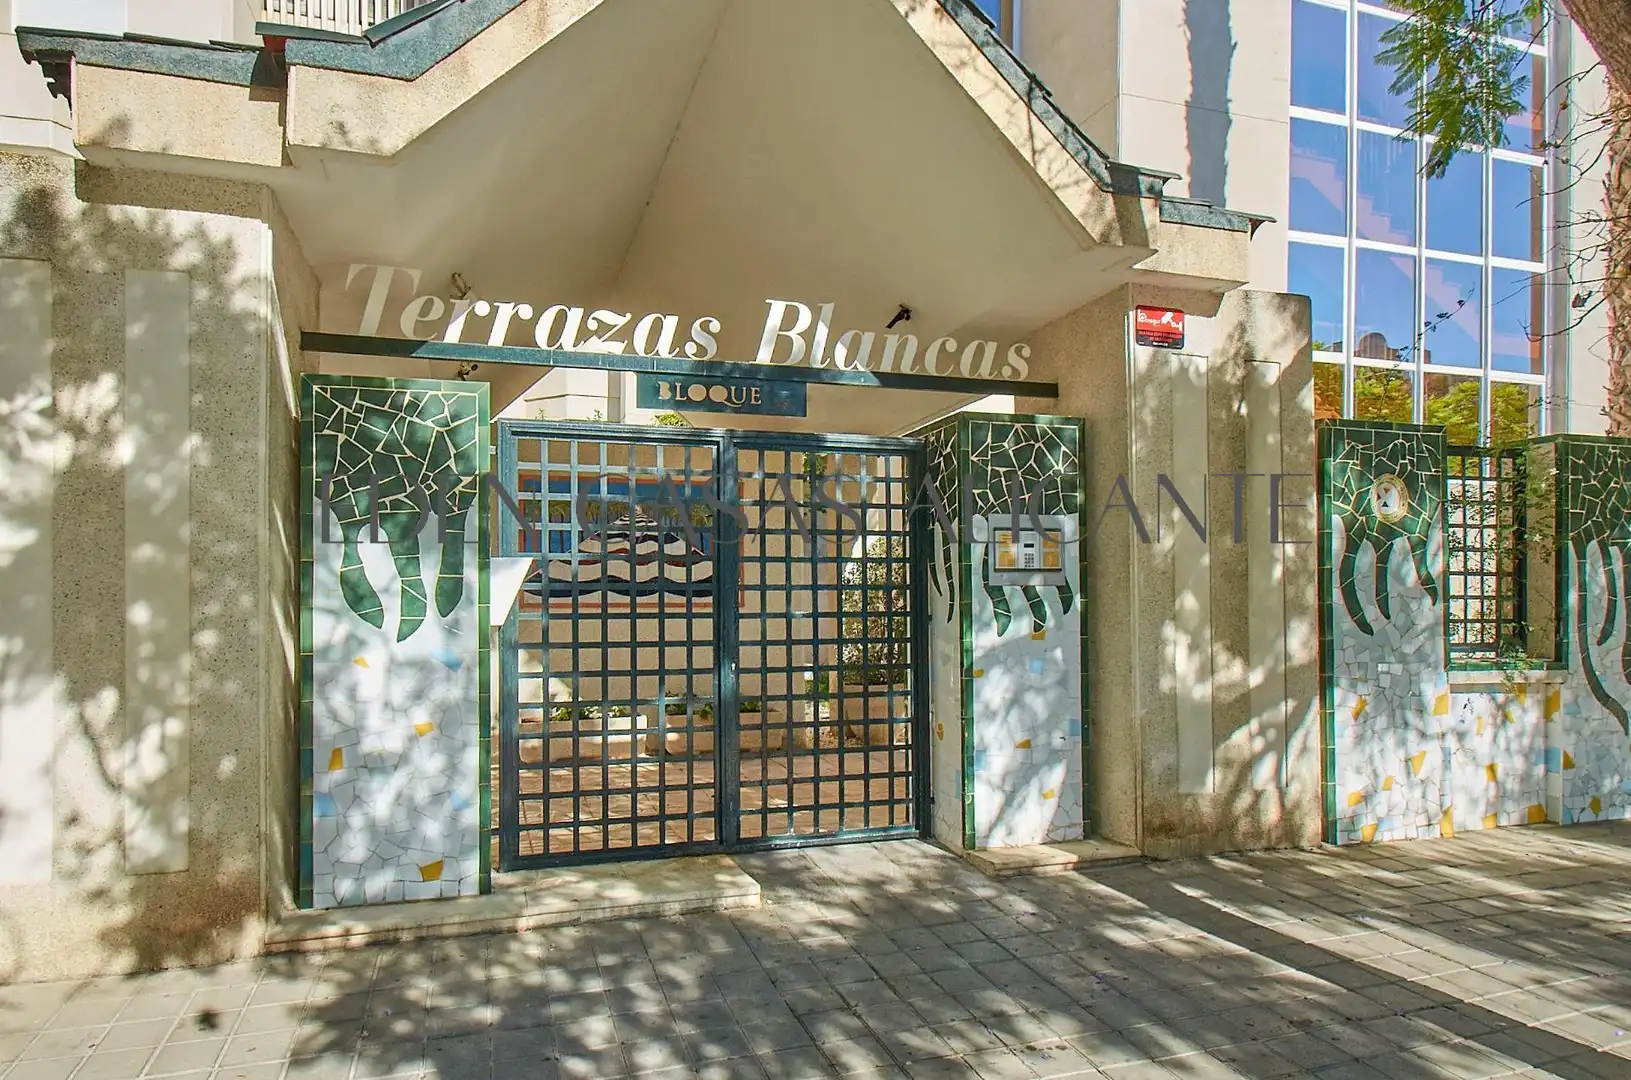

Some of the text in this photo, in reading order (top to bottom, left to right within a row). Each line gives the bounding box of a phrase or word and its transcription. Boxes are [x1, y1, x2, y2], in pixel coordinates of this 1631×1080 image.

[344, 263, 1031, 381] Terrazas Blancas
[657, 381, 762, 408] BLOQUE
